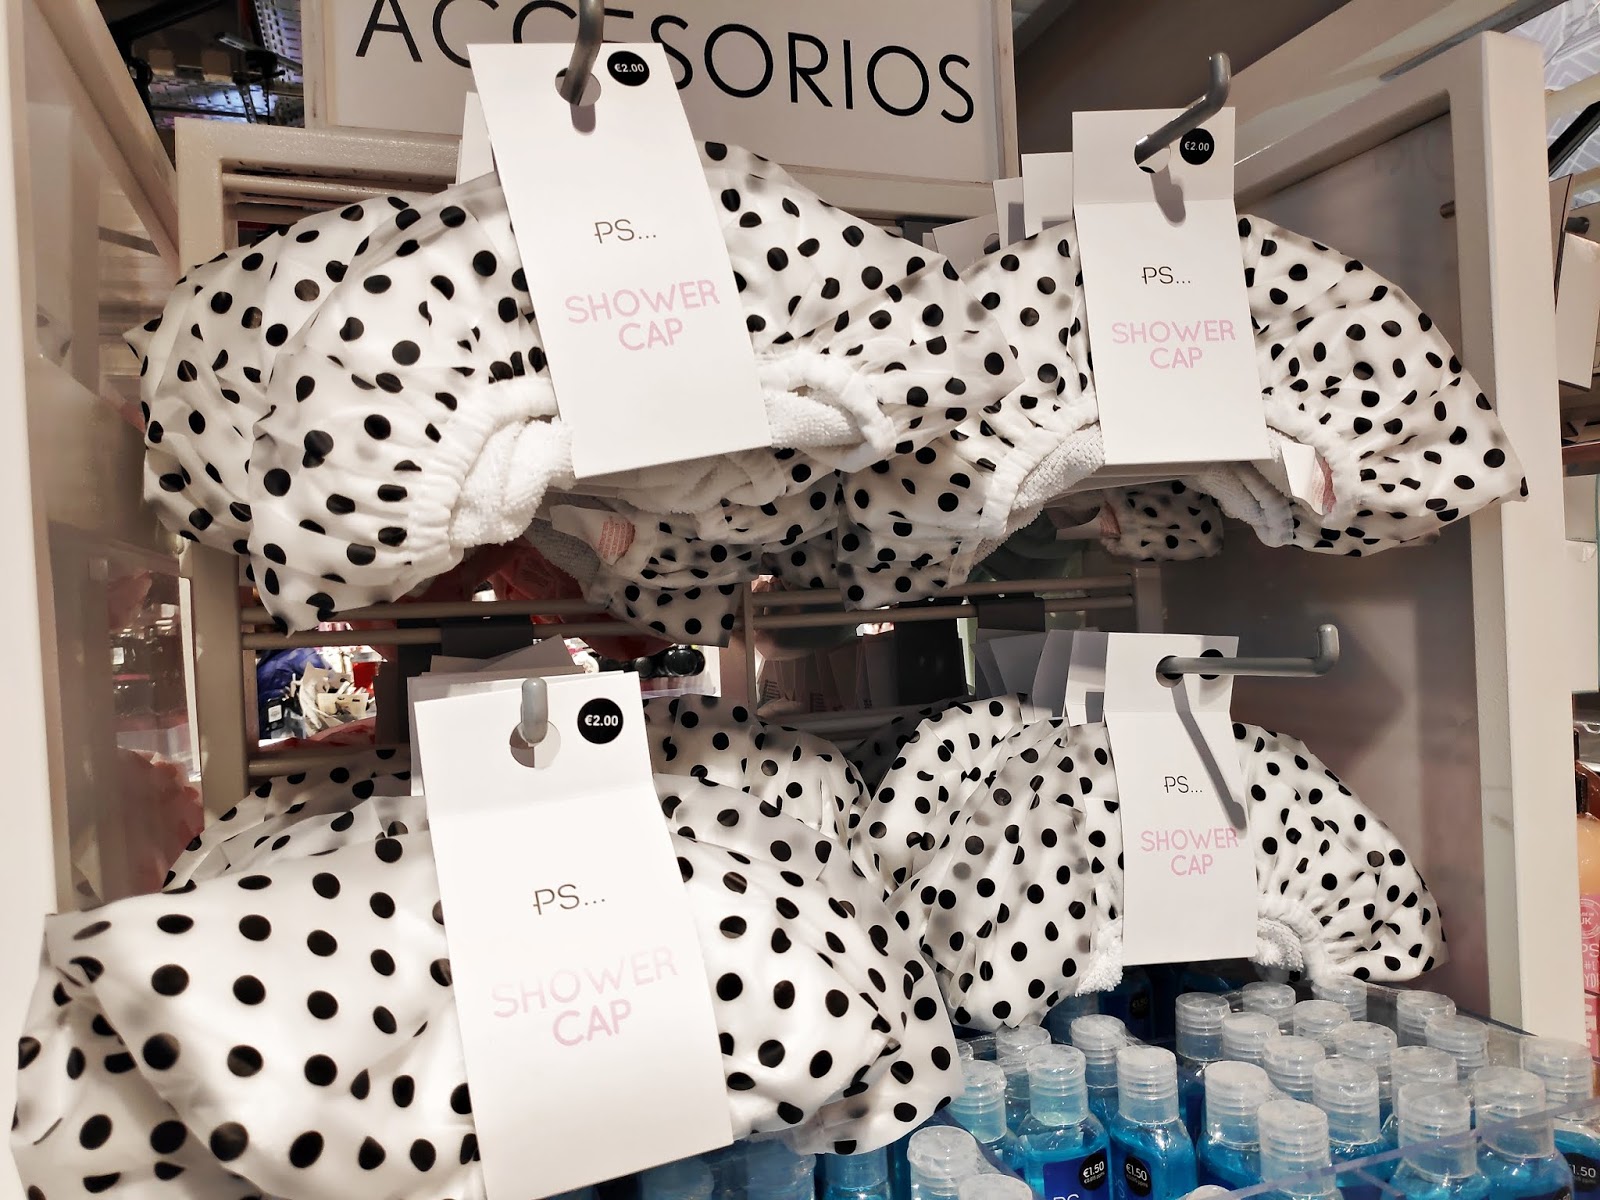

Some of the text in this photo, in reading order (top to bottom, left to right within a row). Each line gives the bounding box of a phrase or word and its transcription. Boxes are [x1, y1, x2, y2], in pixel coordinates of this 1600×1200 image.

[614, 63, 645, 74] €2.00
[1185, 141, 1209, 152] €2.00
[594, 218, 657, 244] PS...
[1141, 266, 1191, 285] PS...
[565, 279, 720, 325] SHOWER
[618, 317, 684, 351] CAP
[1112, 319, 1236, 344] SHOWER
[1150, 346, 1204, 369] CAP
[584, 713, 619, 728] €2.00
[1163, 775, 1204, 794] PS...
[1140, 827, 1239, 853] SHOWER
[1170, 854, 1215, 877] CAP
[532, 883, 606, 916] PS...
[491, 945, 679, 1019] SHOWER
[552, 999, 634, 1048] CAP
[1082, 1160, 1105, 1178] €1.50
[1125, 1163, 1148, 1181] €1.50
[1569, 1164, 1597, 1178] 1.50
